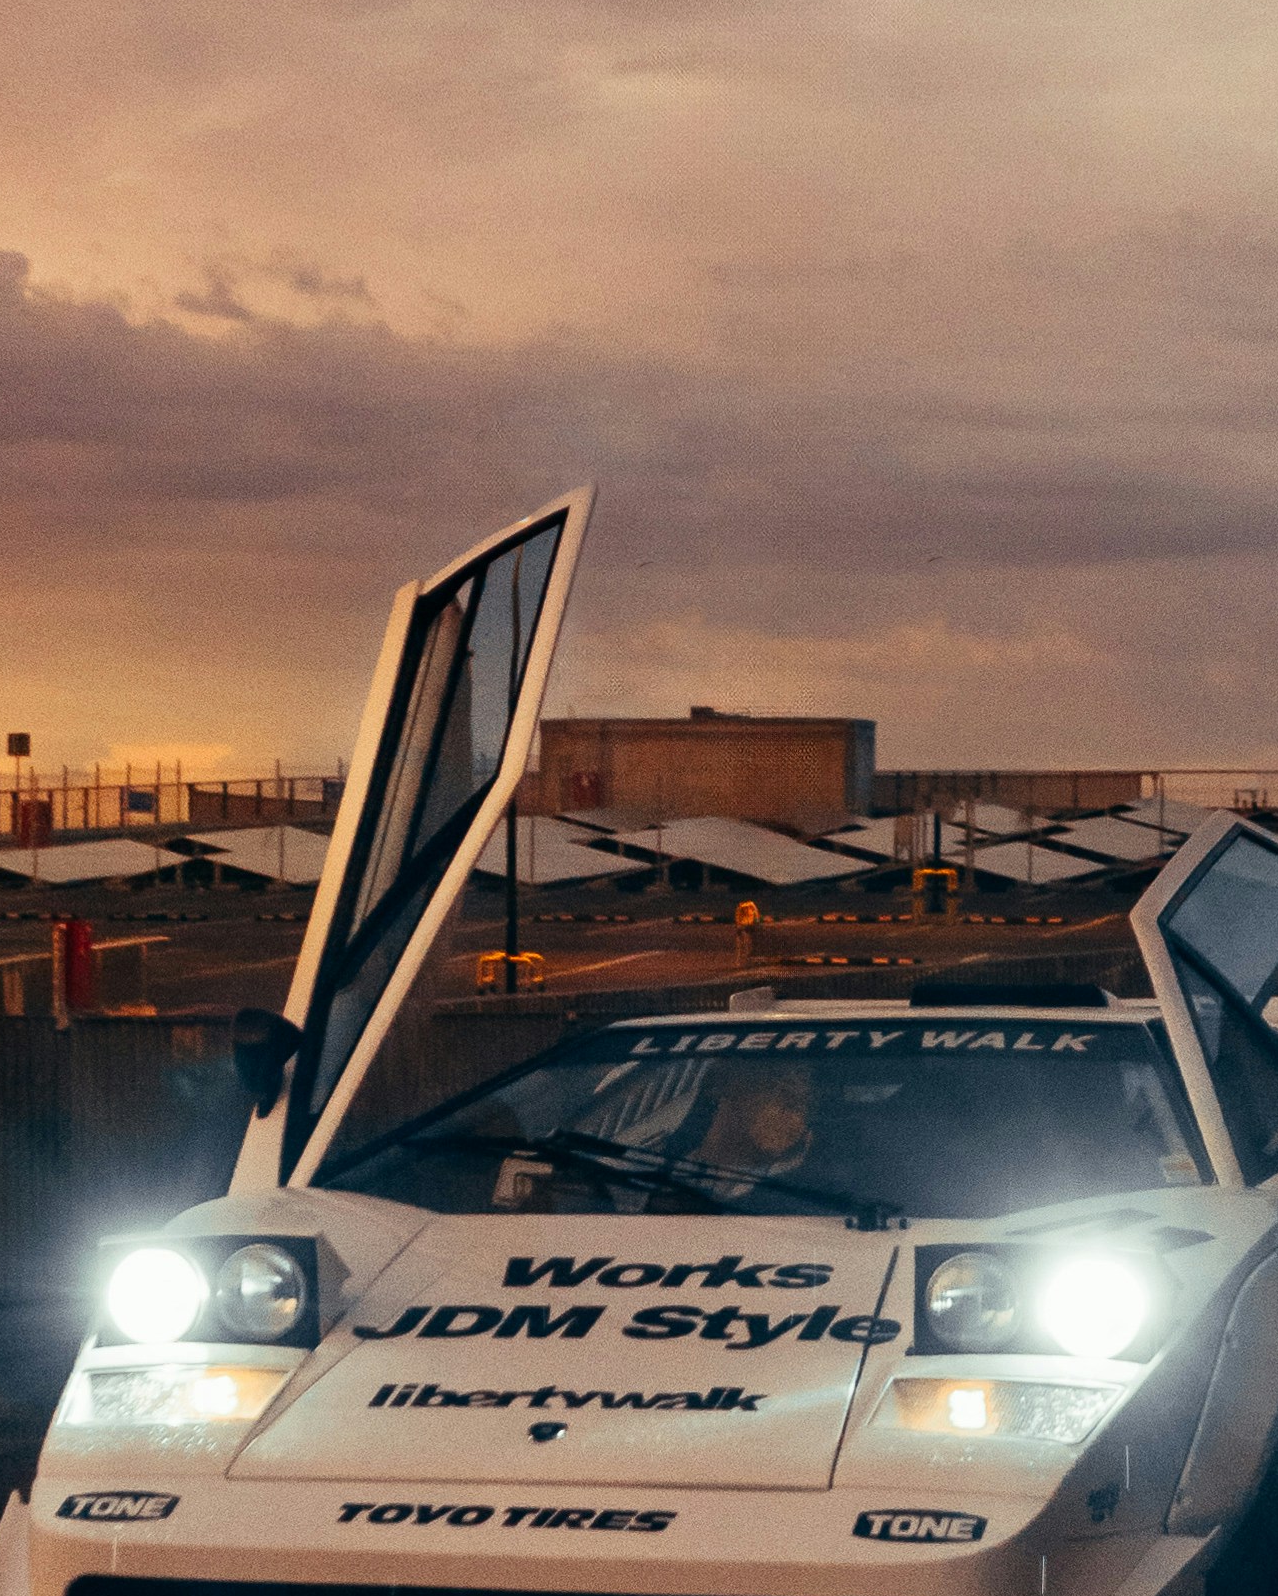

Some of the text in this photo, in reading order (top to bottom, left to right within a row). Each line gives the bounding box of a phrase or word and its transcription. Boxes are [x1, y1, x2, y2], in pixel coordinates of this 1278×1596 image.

[629, 1030, 1098, 1054] LIBERTY WALK
[503, 1256, 835, 1289] Works
[353, 1304, 902, 1350] JDM Style
[368, 1384, 768, 1411] libertywalk
[68, 1495, 171, 1518] TONE
[337, 1503, 677, 1532] TOYO TIRES
[866, 1514, 978, 1539] TONE
